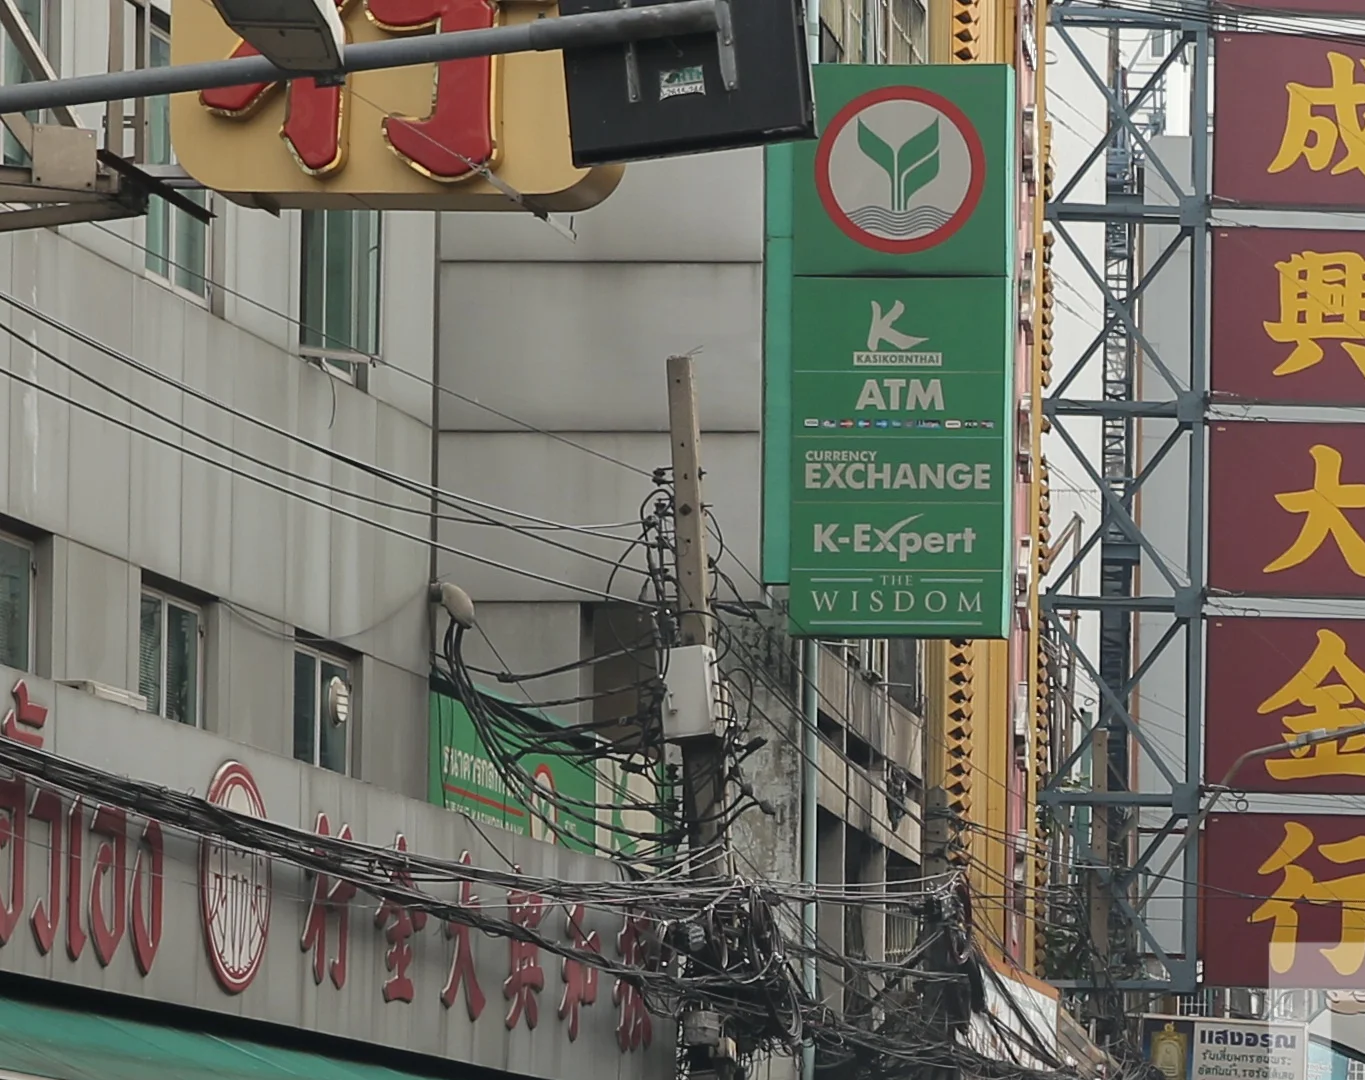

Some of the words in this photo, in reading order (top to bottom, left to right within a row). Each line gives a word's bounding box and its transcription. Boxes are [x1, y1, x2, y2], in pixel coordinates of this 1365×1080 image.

[856, 354, 940, 364] KASIKORNTHAI
[855, 379, 945, 411] ATM
[805, 450, 877, 462] CURRENCY
[805, 464, 991, 490] EXCHANGE
[812, 513, 977, 562] K-Expert
[880, 575, 914, 586] THE
[811, 590, 983, 613] WISDOM
[1200, 1029, 1297, 1054] แสงอรุณ
